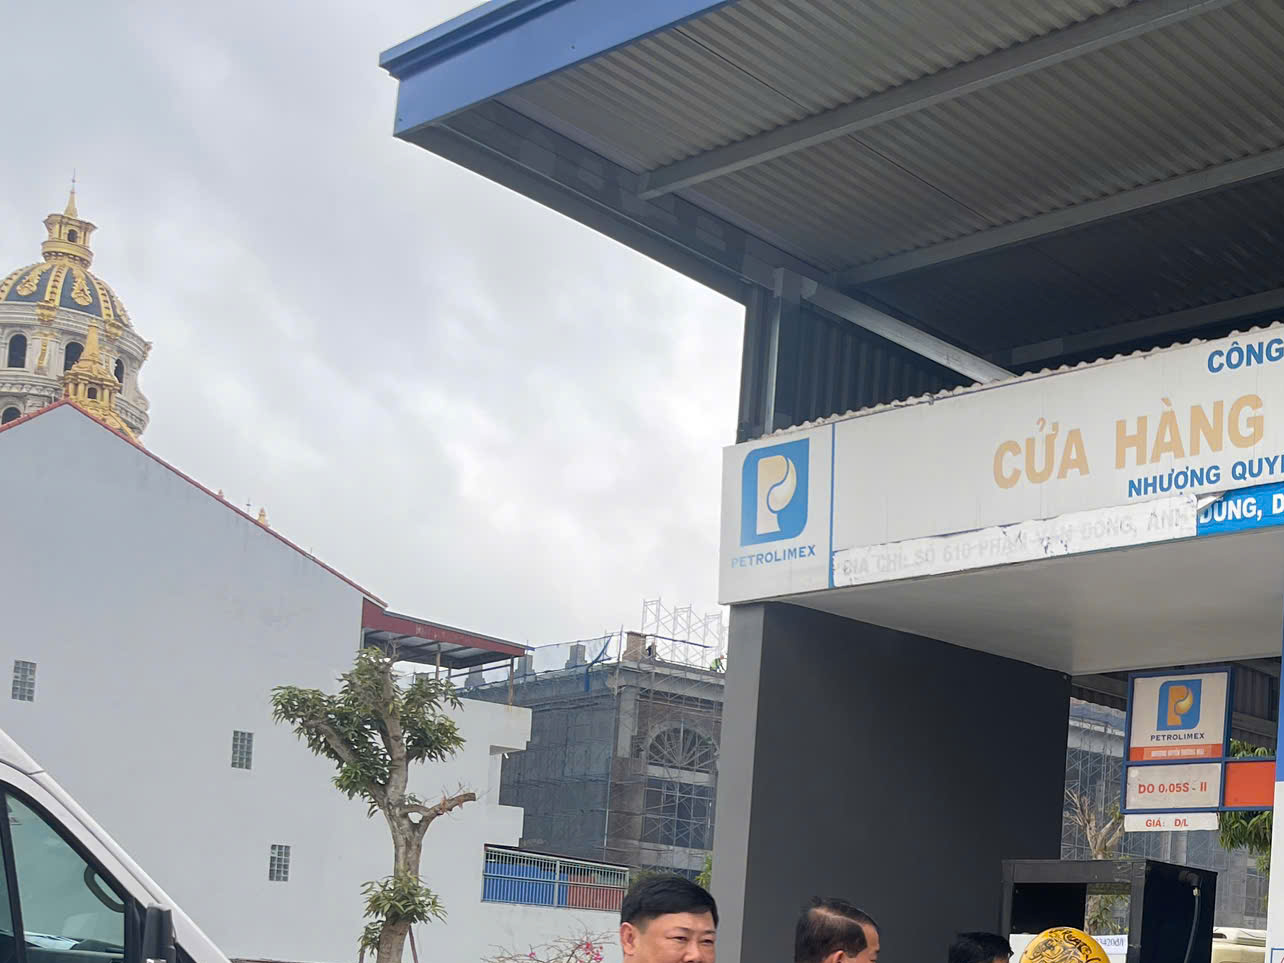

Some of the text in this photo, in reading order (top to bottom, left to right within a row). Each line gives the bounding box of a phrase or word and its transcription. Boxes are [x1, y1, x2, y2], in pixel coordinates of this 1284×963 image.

[1207, 336, 1284, 373] CÔNG
[993, 417, 1090, 490] CỬA
[1115, 397, 1264, 470] HÀNG
[1128, 465, 1221, 498] NHƯỢNG
[731, 544, 816, 568] PETROLIMEX
[1150, 732, 1205, 741] PETROLIMEX
[1138, 783, 1155, 794] DO
